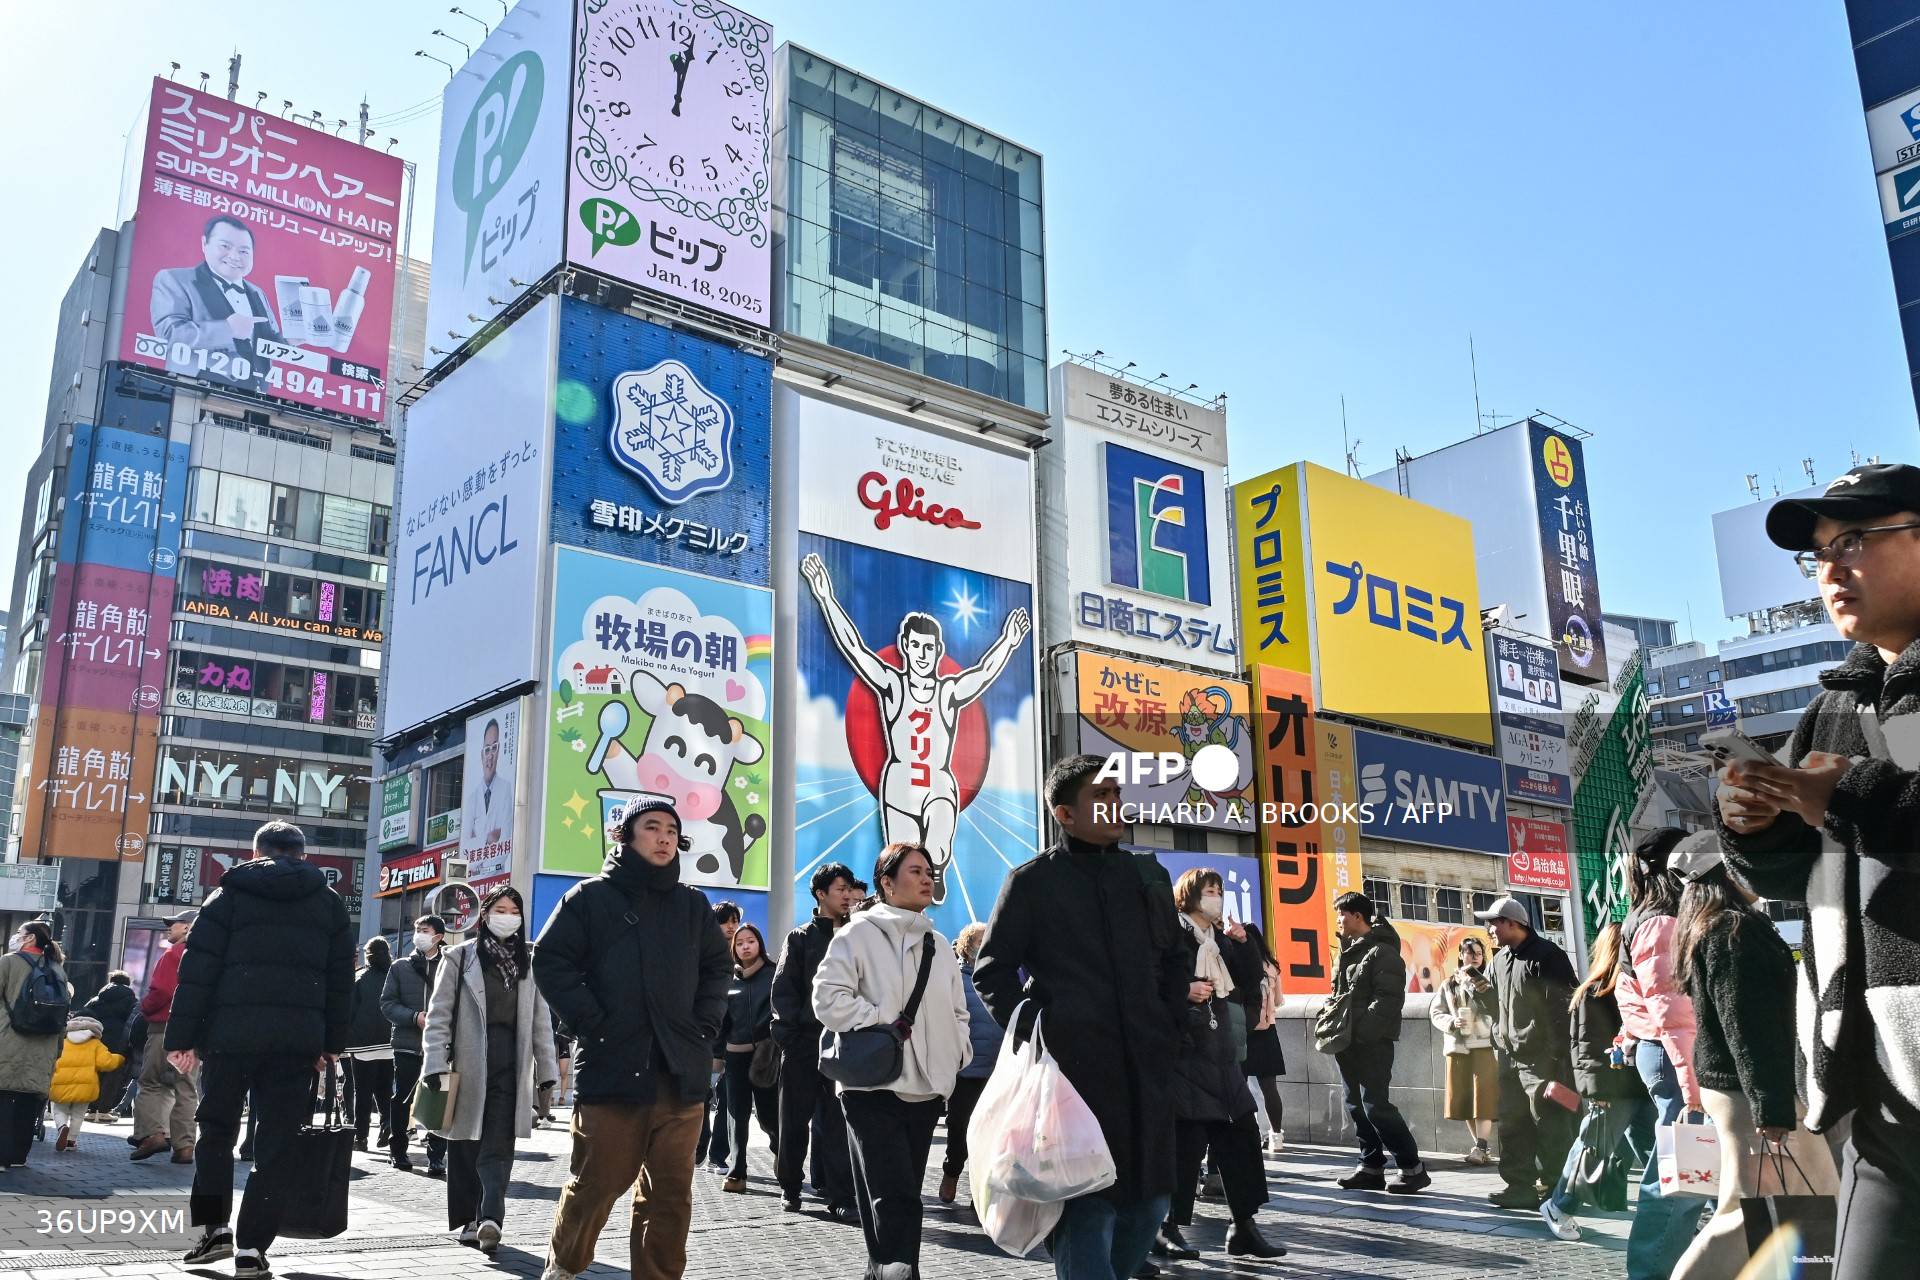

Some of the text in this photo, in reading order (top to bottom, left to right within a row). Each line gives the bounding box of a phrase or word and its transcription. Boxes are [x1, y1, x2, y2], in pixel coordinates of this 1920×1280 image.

[608, 26, 636, 56] 10
[636, 16, 660, 40] 11
[667, 20, 693, 48] 12
[600, 61, 622, 82] 9
[705, 49, 719, 65] 1
[609, 101, 631, 118] 8
[722, 81, 744, 97] 2
[161, 87, 298, 144] スーパー
[731, 115, 752, 134] 3
[159, 118, 395, 207] ミリオンヘアー
[636, 133, 658, 151] 7
[724, 143, 743, 165] 4
[669, 154, 685, 177] 6
[702, 157, 719, 181] 5
[155, 153, 393, 238] SUPER MILLION HAIR
[480, 179, 541, 274] ピップ
[650, 220, 727, 273] ピップ
[719, 290, 762, 315] 2025
[261, 344, 305, 362] ルアン
[341, 362, 369, 380] 検索
[168, 342, 381, 413] 0120-494-111
[1109, 382, 1188, 421] 夢ある住まい
[1097, 405, 1203, 451] エステムシリーズ
[1550, 438, 1569, 483] 占
[407, 440, 538, 537] なにげない感動をずっと。
[858, 471, 982, 530] Glico
[590, 498, 748, 553] 雪印メグミルク
[412, 494, 518, 605] FANCL
[1250, 483, 1290, 651] プロミス
[1553, 494, 1584, 611] 千里眼
[202, 566, 264, 602] 焼肉
[248, 611, 268, 624] All
[272, 616, 300, 629] you
[304, 621, 330, 634] can
[334, 626, 357, 638] eat
[647, 607, 693, 624] まきばのあさ
[1080, 591, 1237, 656] 日商エステム
[1325, 560, 1472, 652] プロミス
[595, 612, 737, 673] 牧場の朝
[199, 662, 251, 690] 力丸
[621, 655, 654, 668] Makiba
[670, 663, 686, 674] Asa
[688, 667, 715, 679] Yogurt
[1100, 666, 1161, 697] かぜに
[1093, 691, 1168, 736] 改源
[908, 707, 933, 788] グリコ
[160, 757, 345, 808] NY NY
[1394, 769, 1501, 824] SAMTY
[469, 840, 511, 863] 東京美容外科
[158, 852, 174, 897] 焼きそば
[181, 848, 197, 903] お好み焼き
